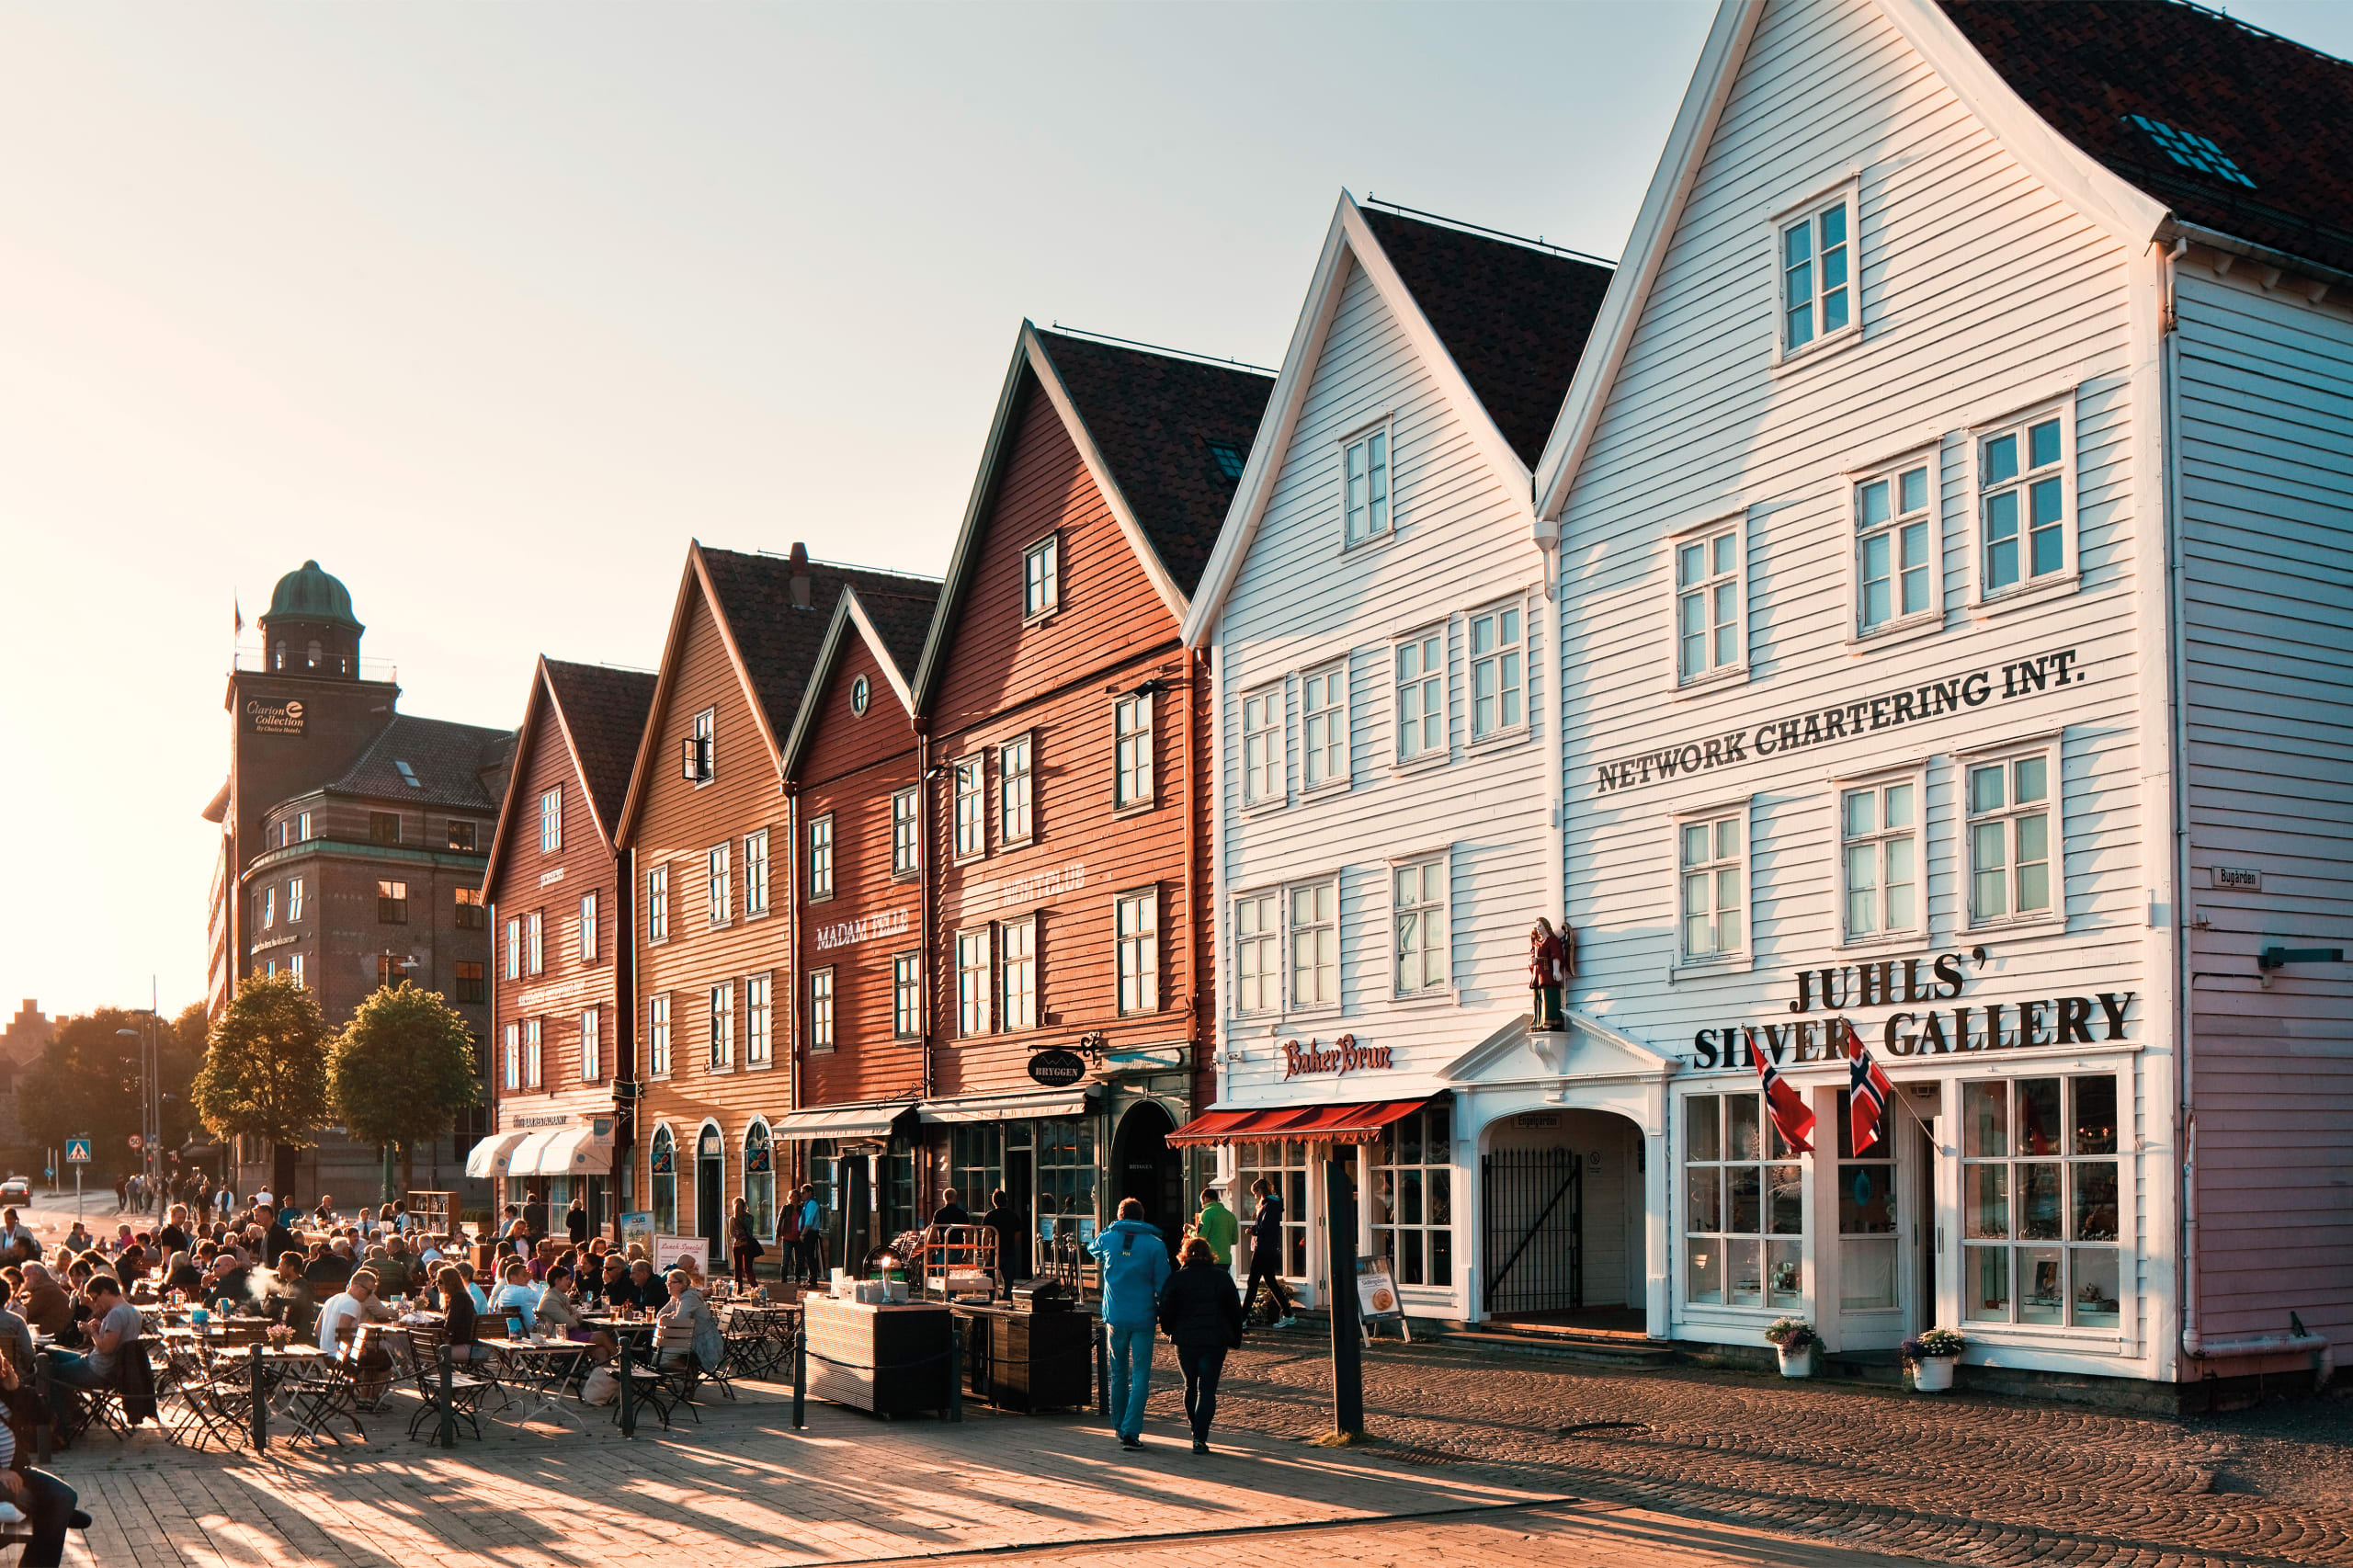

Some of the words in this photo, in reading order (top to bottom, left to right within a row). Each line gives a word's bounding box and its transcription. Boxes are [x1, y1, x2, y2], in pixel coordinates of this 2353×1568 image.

[246, 699, 285, 716] Clarion
[256, 715, 303, 727] Collection
[1597, 732, 1748, 793] NETWORK
[1755, 671, 1993, 756] CHARTERING
[2001, 649, 2086, 699] INT.
[2221, 869, 2256, 886] Bugården
[817, 917, 869, 951] MADAM
[1694, 1017, 1853, 1069] SILVER
[1884, 992, 2136, 1056] GALLERY
[1035, 1066, 1078, 1077] BRYGGEN
[661, 1242, 679, 1250] Lunch
[680, 1243, 704, 1253] Special
